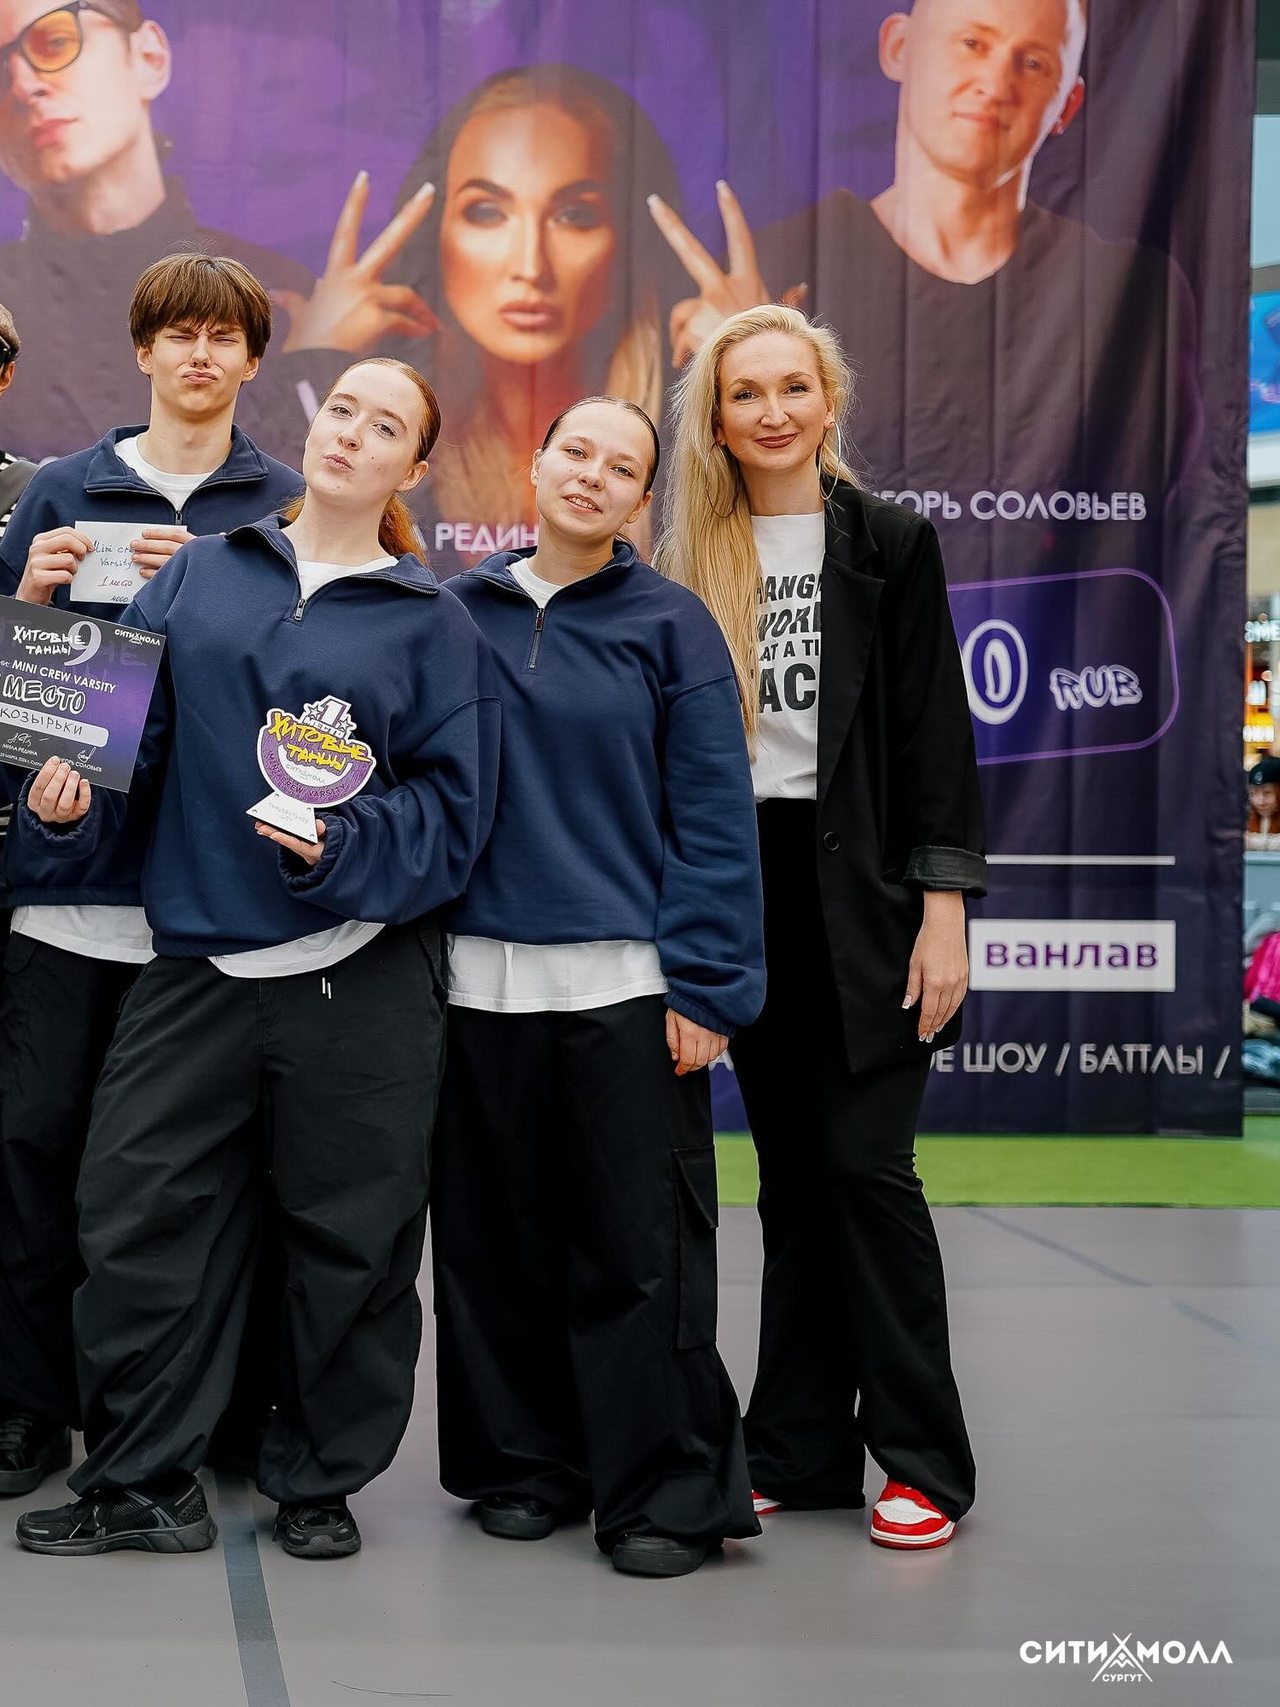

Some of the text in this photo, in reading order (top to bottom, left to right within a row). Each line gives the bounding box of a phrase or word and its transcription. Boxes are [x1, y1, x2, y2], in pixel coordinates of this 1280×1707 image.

[970, 490, 1147, 521] СОЛОВЬЕВ
[435, 522, 538, 554] РЕДИН
[12, 625, 86, 645] ХИТОВЫЕ
[25, 644, 71, 656] ТАНЦЫ
[12, 660, 38, 675] MINI
[40, 667, 72, 683] CREW
[73, 675, 116, 694] VARSITY
[1049, 664, 1143, 711] RUB
[3, 674, 86, 715] МЕСТО
[0, 708, 83, 736] КОЗЫРЬКИ
[303, 717, 346, 738] МЕСТО
[320, 698, 347, 728] 1
[268, 712, 372, 763] ХИТОВЫЕ
[286, 743, 346, 771] ТАНЦЫ
[985, 940, 1159, 970] ванлав
[963, 1042, 1047, 1074] ШОУ
[1079, 1043, 1204, 1075] БАТТЛЫ
